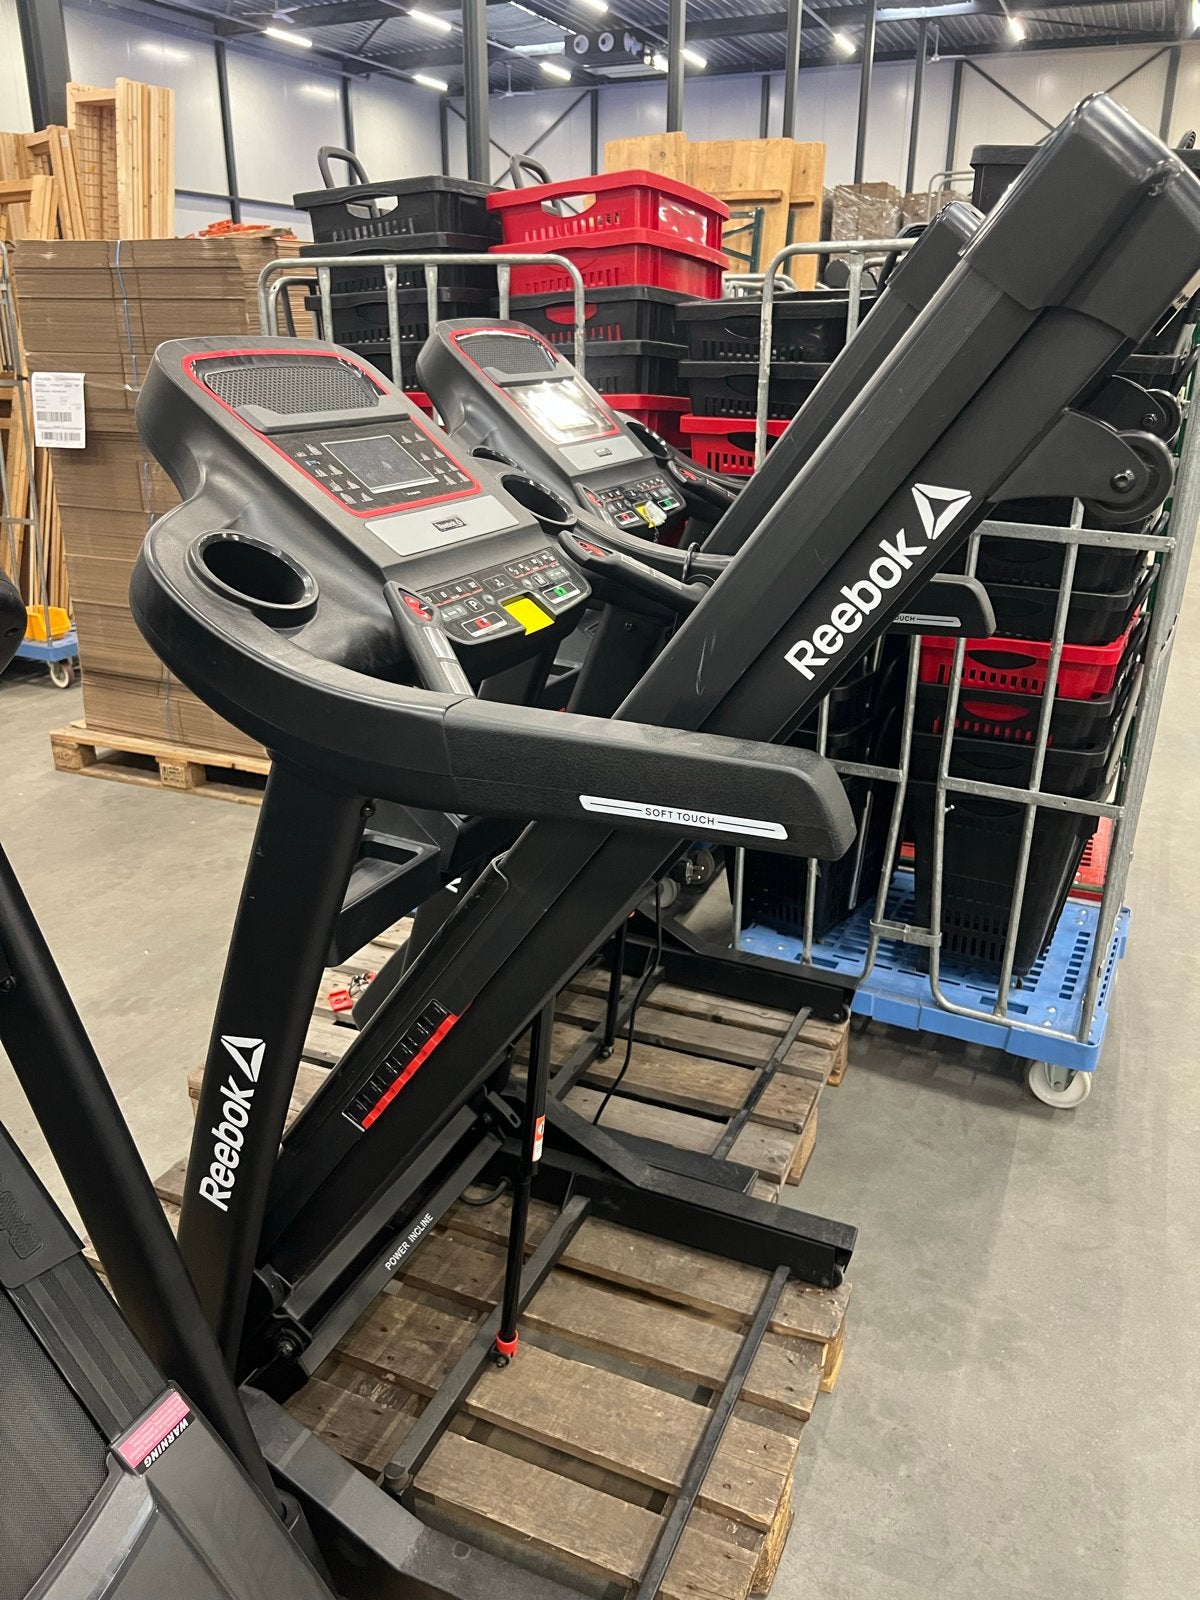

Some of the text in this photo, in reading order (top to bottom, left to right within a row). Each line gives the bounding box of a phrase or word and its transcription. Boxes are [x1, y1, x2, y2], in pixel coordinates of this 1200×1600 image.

[468, 600, 478, 610] P
[784, 528, 927, 681] Reebok
[896, 615, 915, 623] OUCH
[644, 807, 715, 826] SOFT TOUCH
[199, 1075, 255, 1212] Reebok
[384, 1212, 434, 1271] POWER INCLINE
[143, 1418, 189, 1468] WARNING
